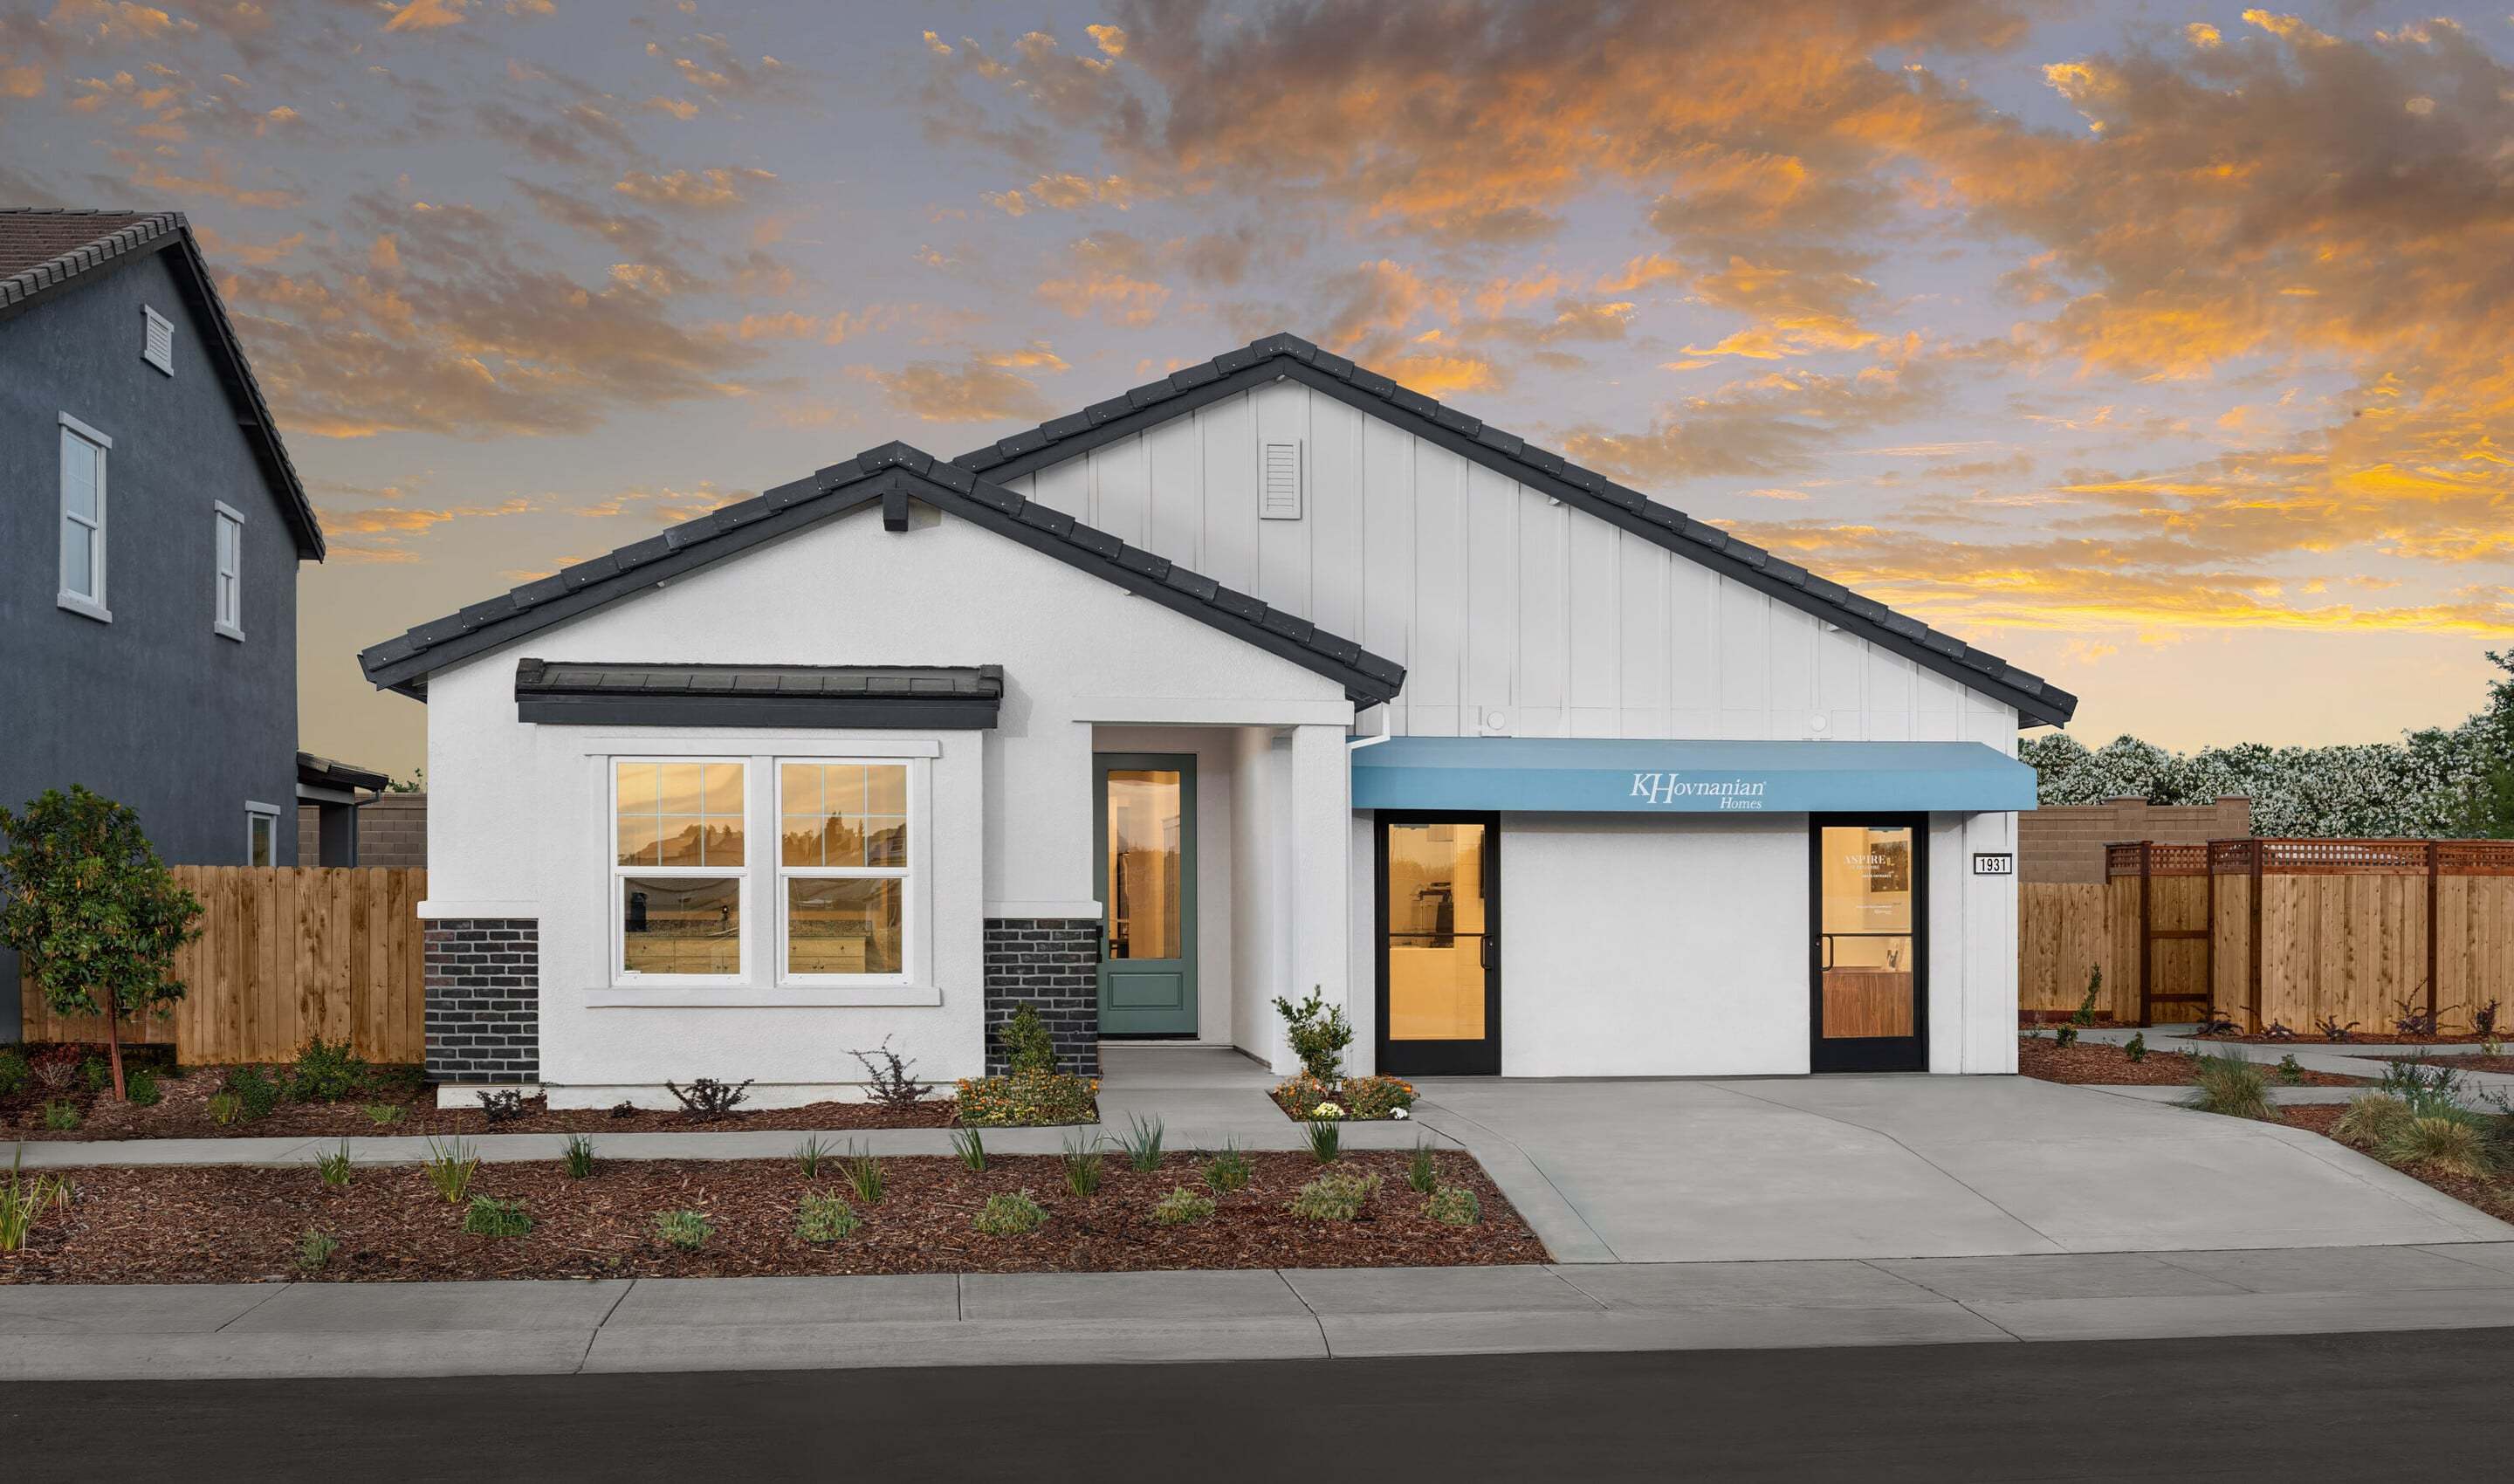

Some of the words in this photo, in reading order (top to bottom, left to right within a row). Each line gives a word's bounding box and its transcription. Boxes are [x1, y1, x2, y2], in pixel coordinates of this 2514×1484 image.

[1720, 796, 1762, 809] Homes
[1843, 855, 1886, 865] ASPIRE
[1981, 858, 2005, 871] 1931
